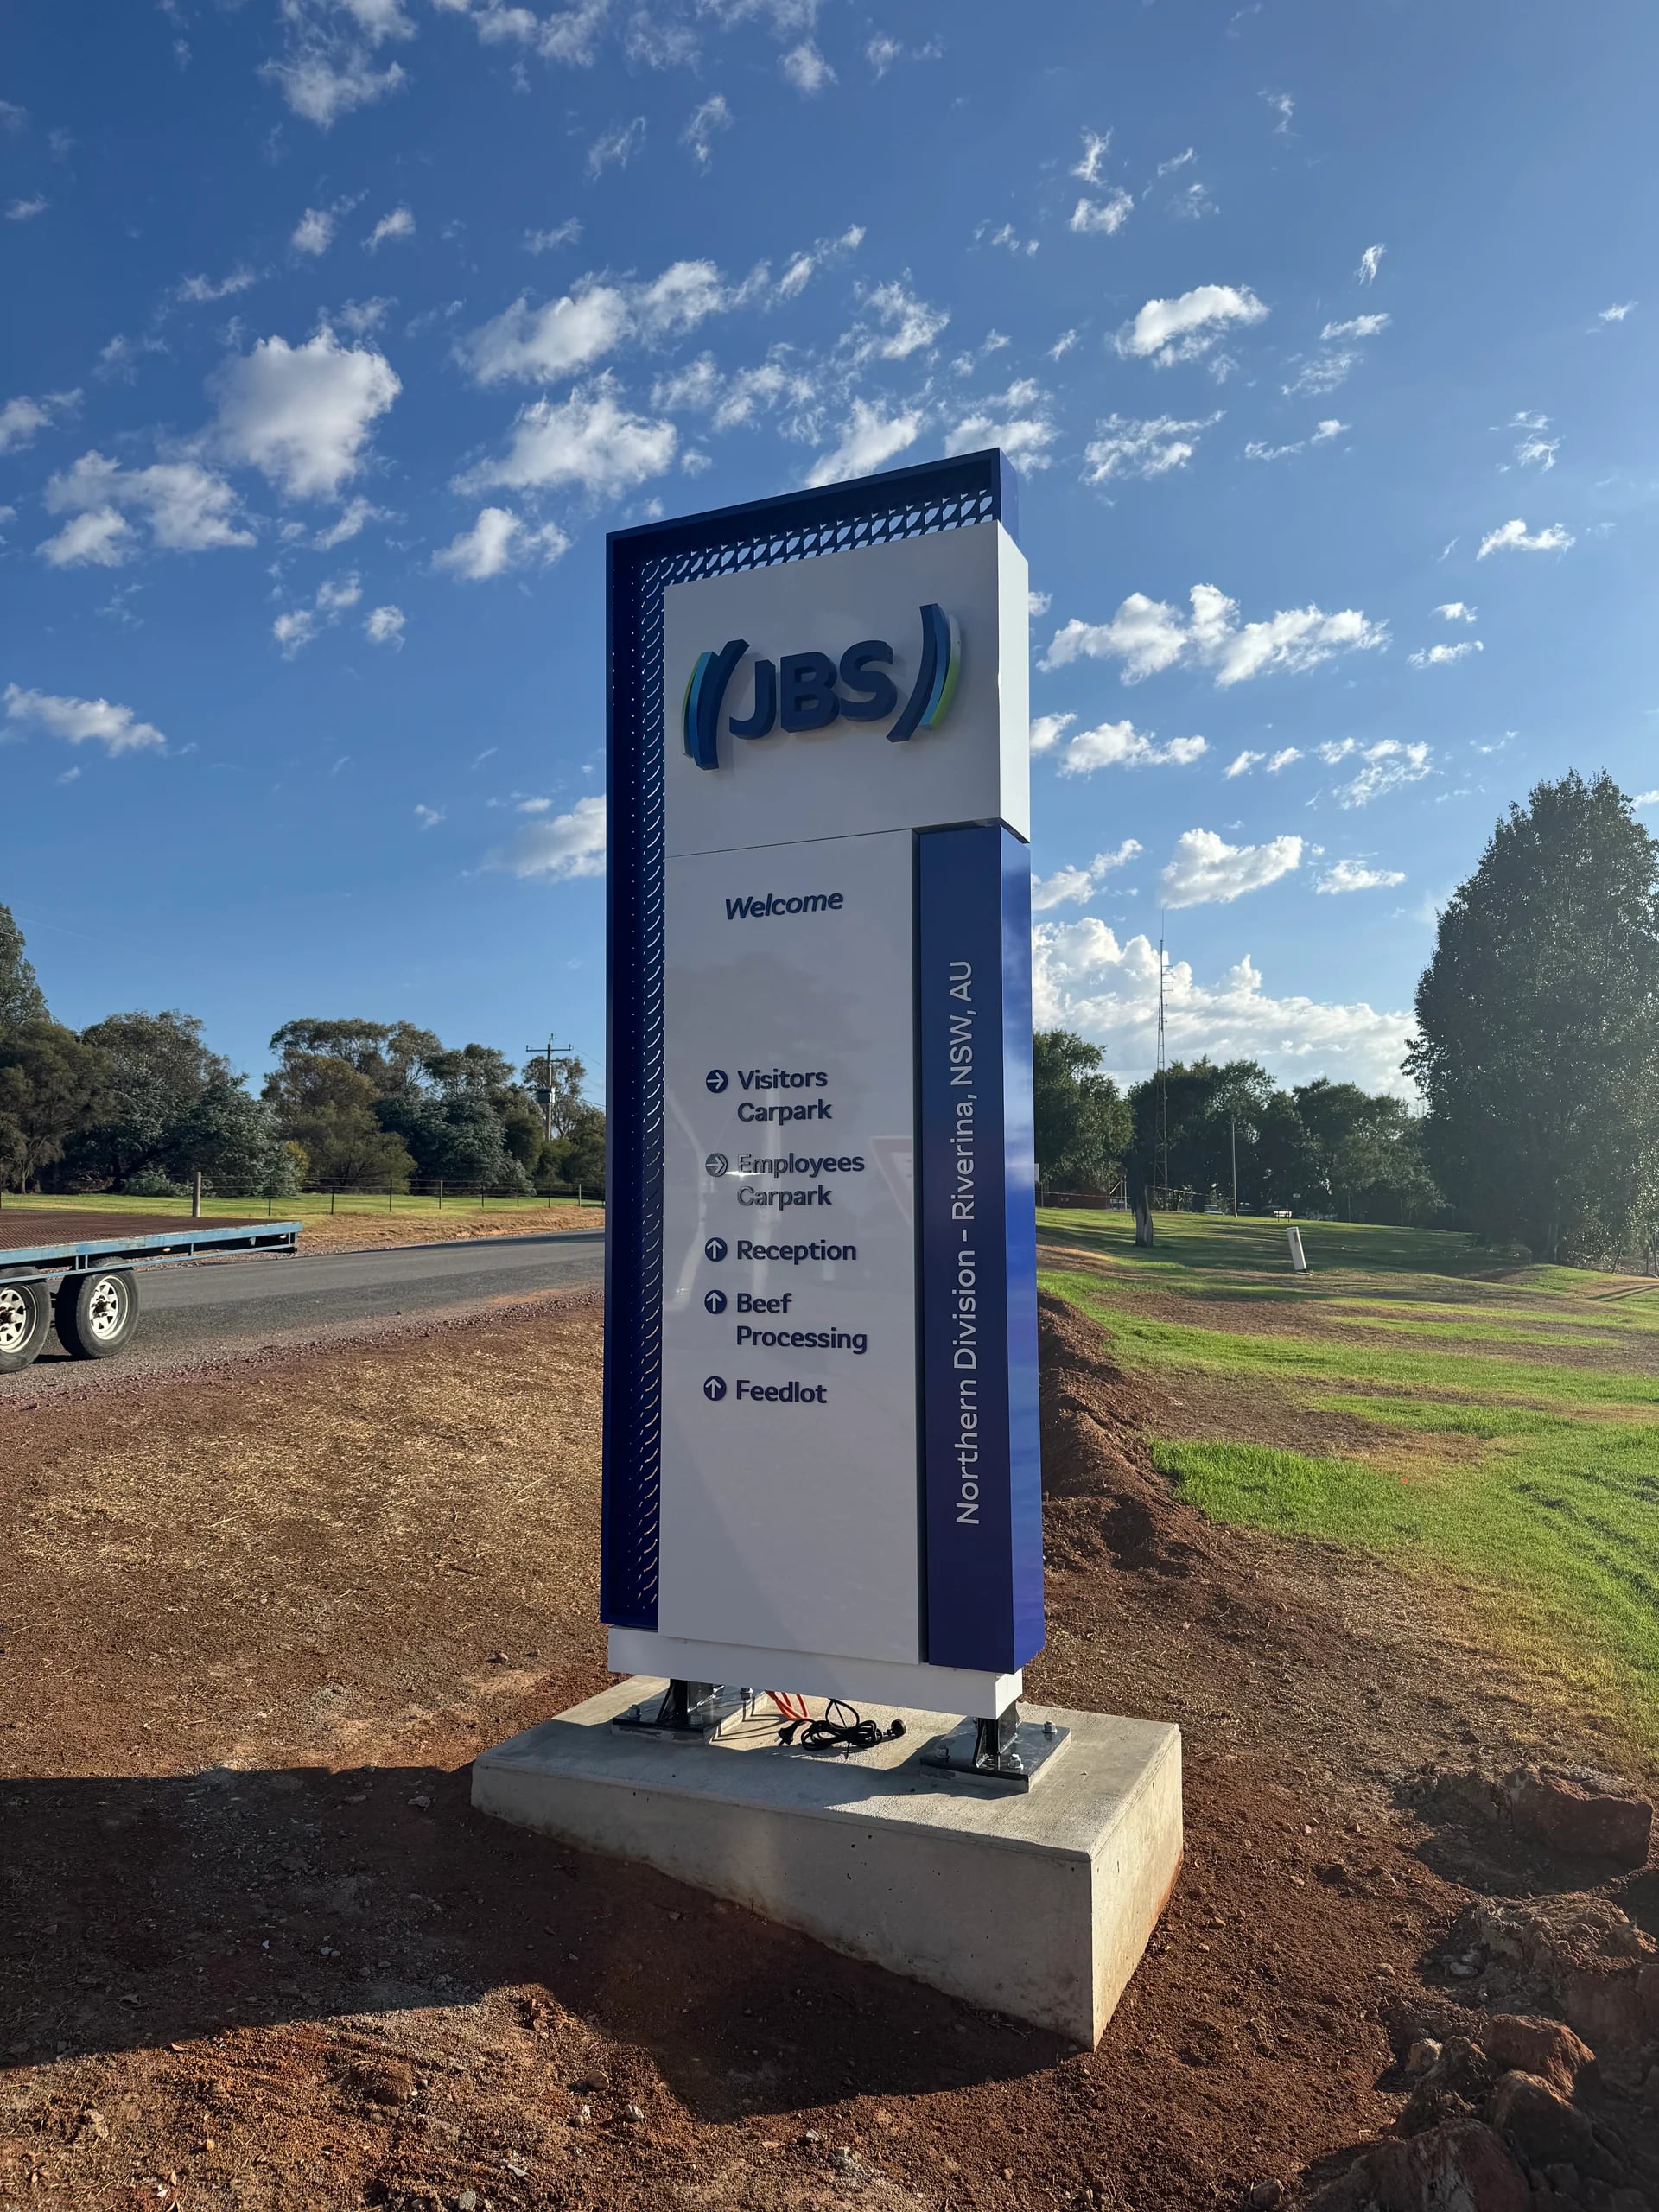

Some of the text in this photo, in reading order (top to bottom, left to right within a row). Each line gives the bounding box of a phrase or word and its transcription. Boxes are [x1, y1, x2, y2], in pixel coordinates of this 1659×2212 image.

[728, 640, 898, 740] JBS
[725, 892, 844, 920] Welcome
[950, 961, 973, 1002] AU
[950, 1010, 976, 1086] NSW,
[737, 1068, 828, 1090] Visitors
[737, 1099, 833, 1125] Carpark
[737, 1153, 865, 1178] Employees
[950, 1094, 977, 1220] Riverina,
[737, 1185, 832, 1211] Carpark
[736, 1239, 857, 1265] Reception
[736, 1293, 792, 1313] Beef
[952, 1250, 977, 1370] Division
[736, 1325, 868, 1354] Processing
[735, 1380, 828, 1404] Feedlot
[954, 1379, 980, 1525] Northern
